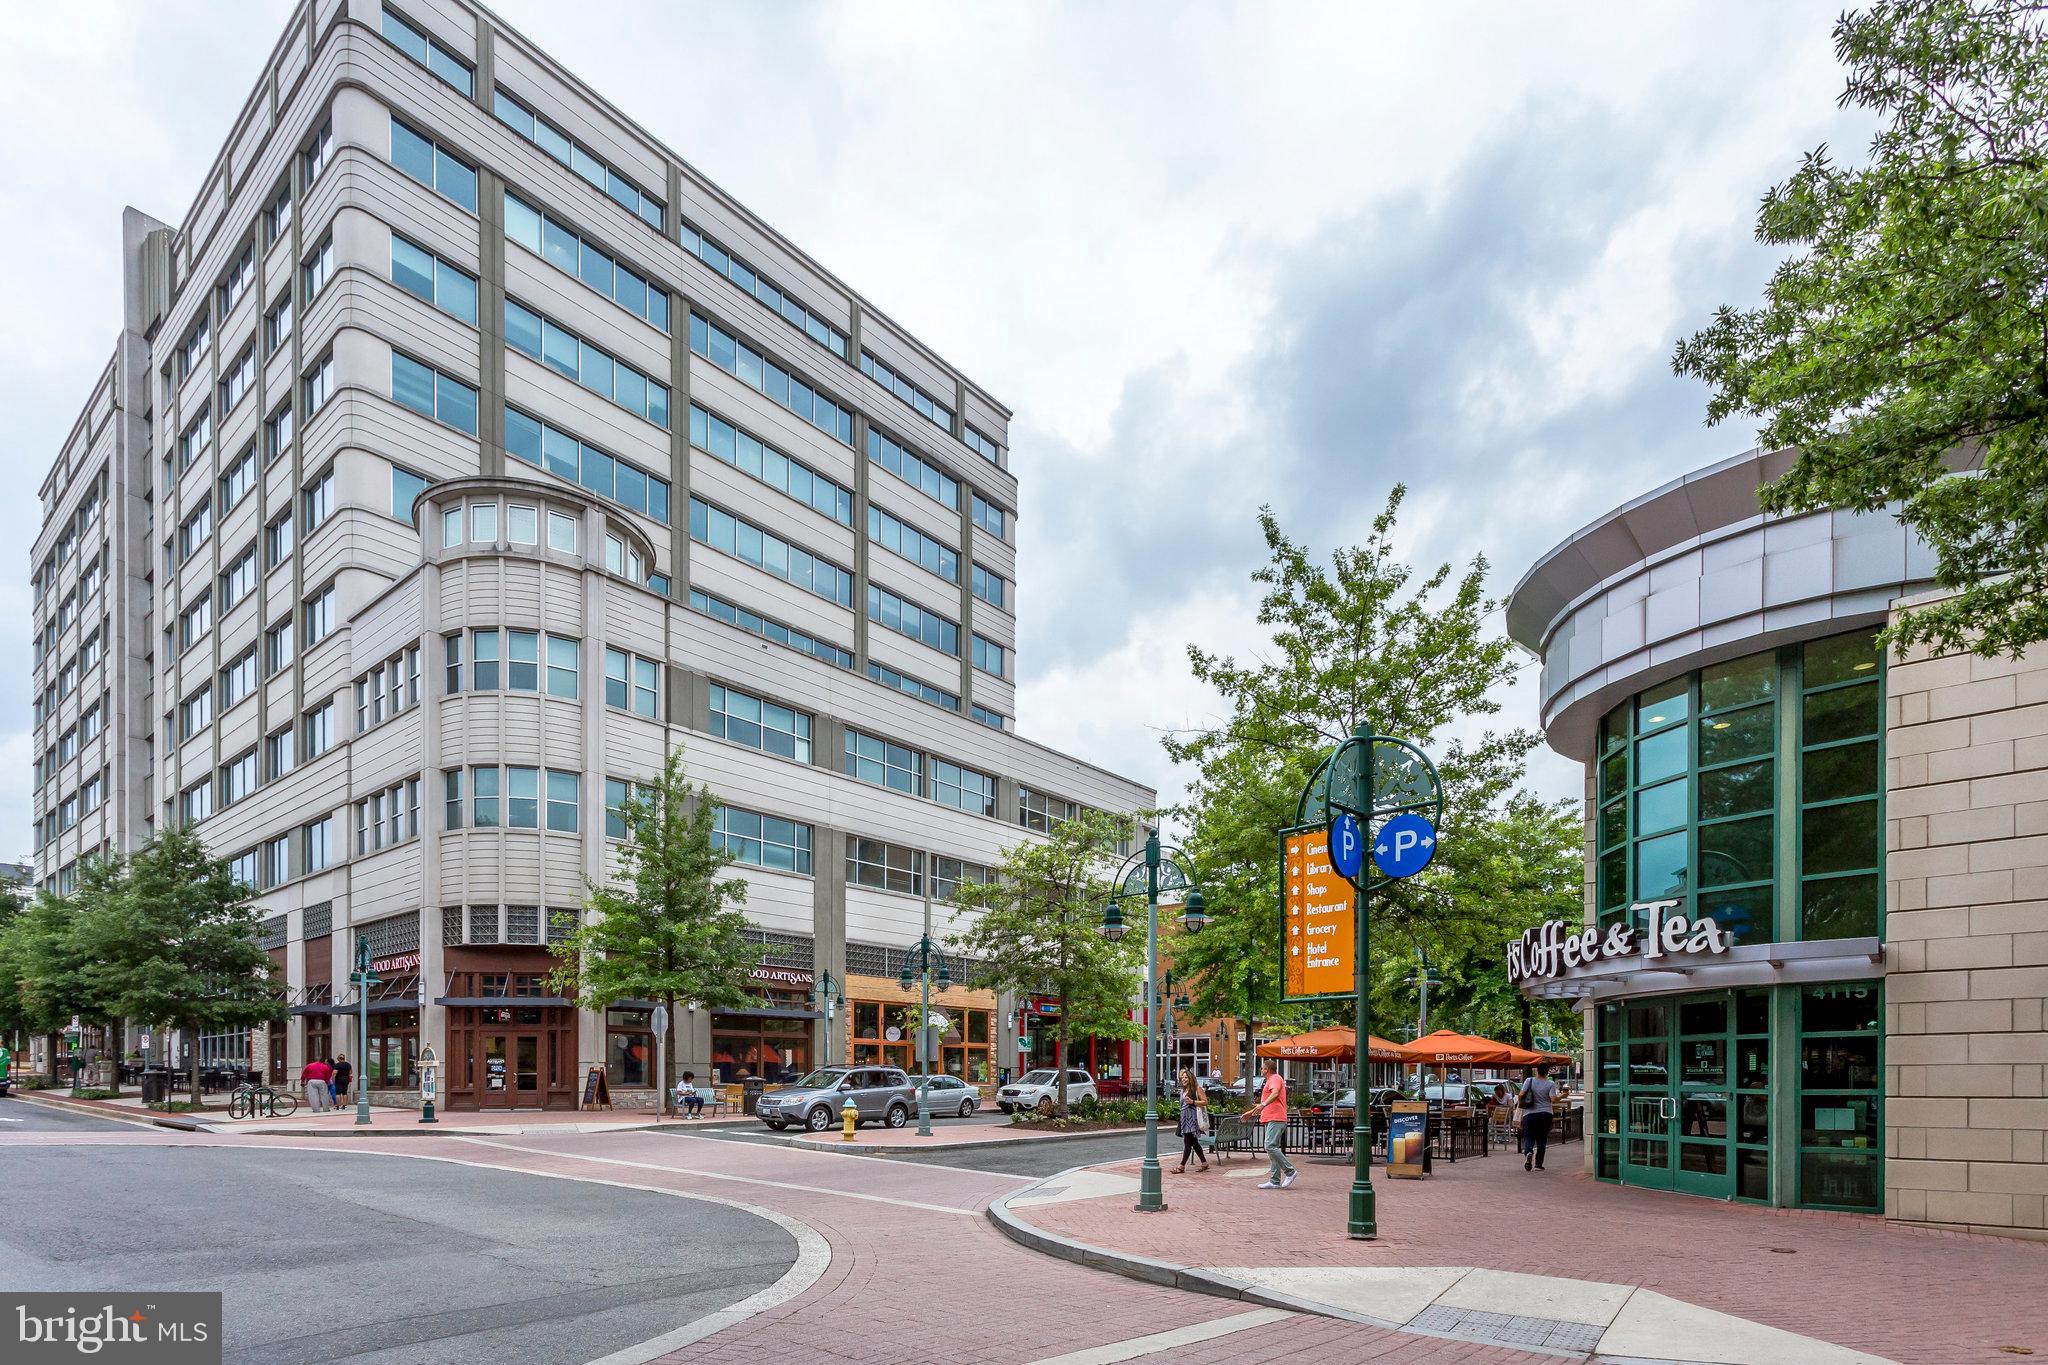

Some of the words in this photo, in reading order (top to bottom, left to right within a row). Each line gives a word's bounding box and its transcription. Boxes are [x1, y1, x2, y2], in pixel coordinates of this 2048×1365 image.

[1306, 842, 1328, 856] Cinem
[1343, 830, 1355, 861] P
[1395, 829, 1418, 862] P
[1306, 862, 1333, 875] Library
[1306, 883, 1327, 897] Shops
[1306, 900, 1348, 916] Restaurant
[1306, 923, 1337, 936] Grocery
[1521, 919, 1599, 979] Coffee
[1602, 922, 1634, 957] &
[1630, 900, 1726, 959] Tea
[1307, 941, 1327, 955] Hotel
[1307, 956, 1340, 969] Entrance
[770, 971, 813, 985] ARTISANS
[1812, 984, 1868, 1000] 4115
[1393, 1115, 1418, 1123] DISCOVER
